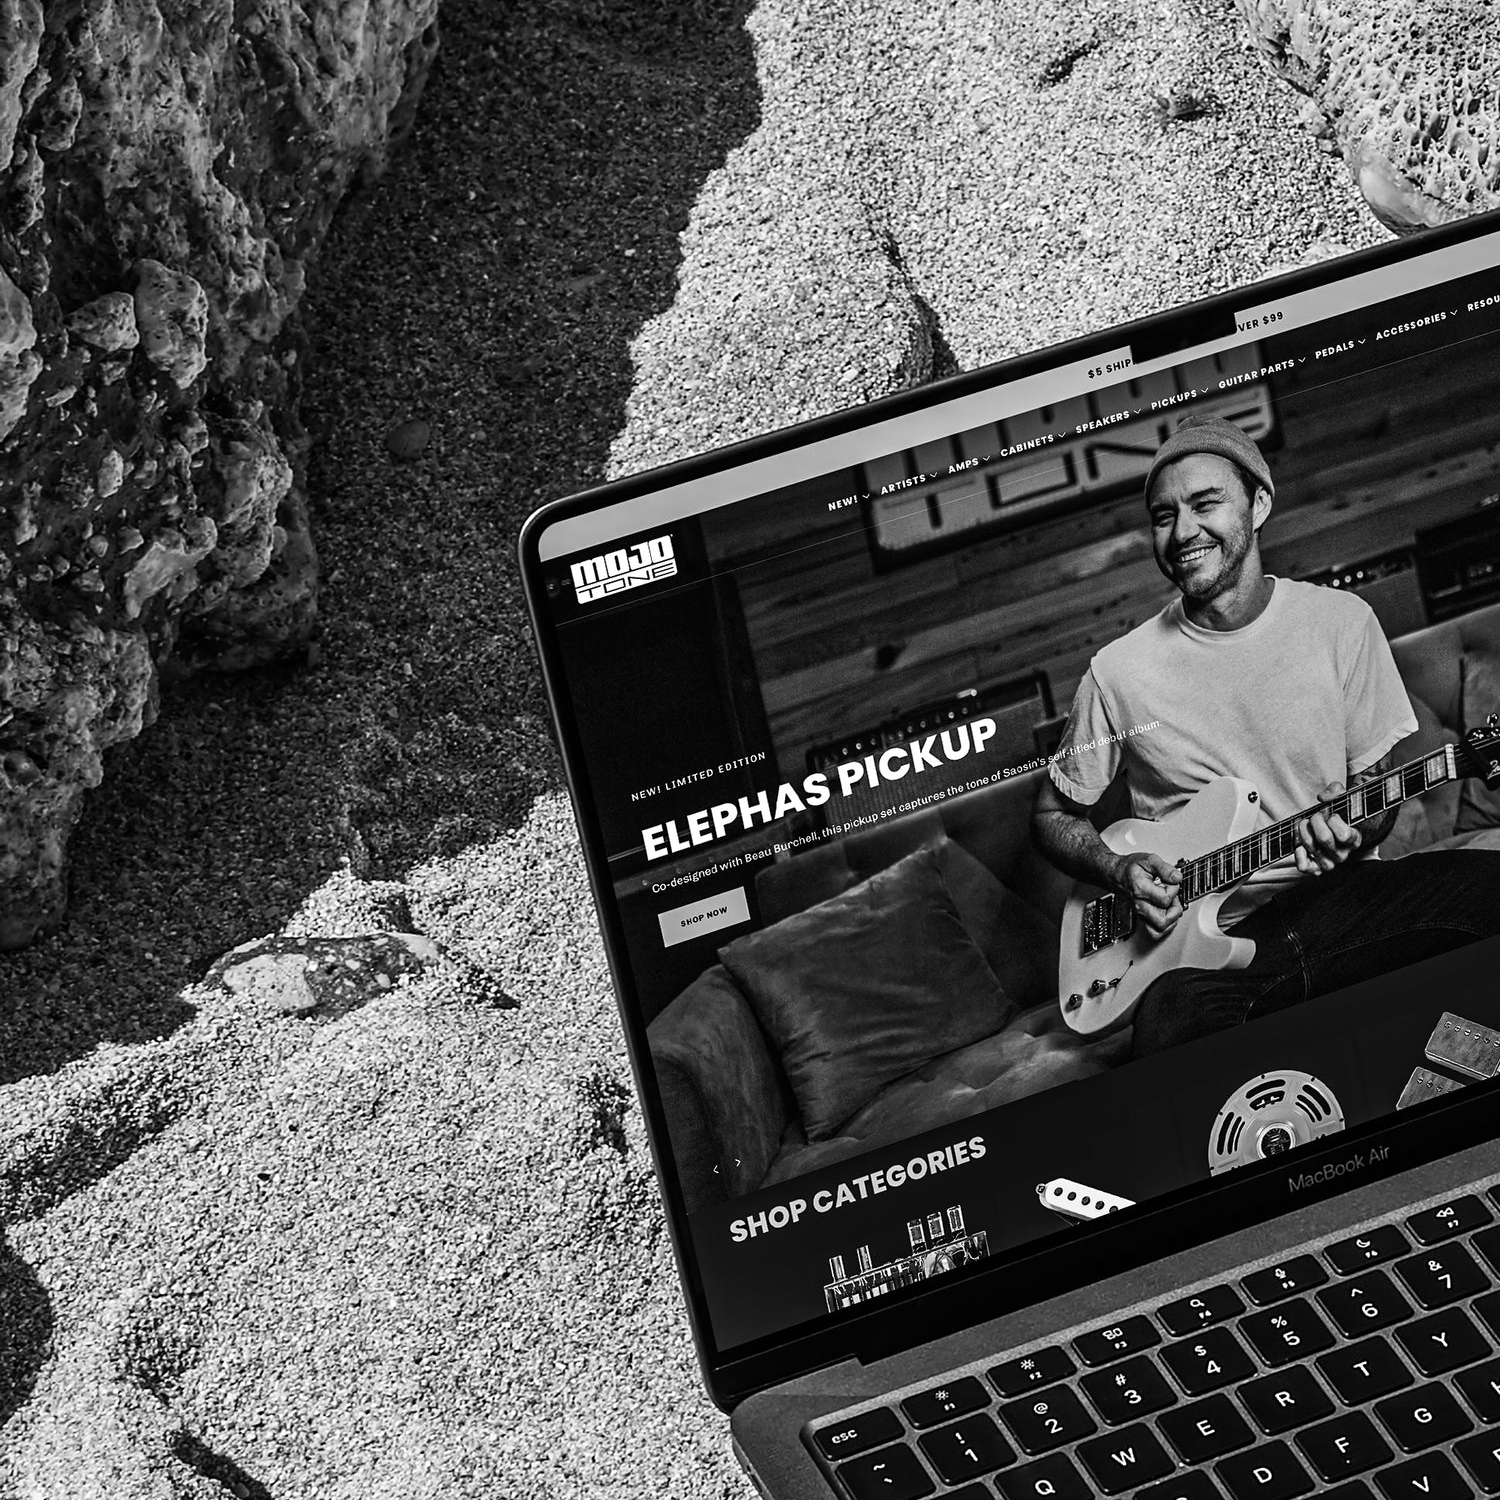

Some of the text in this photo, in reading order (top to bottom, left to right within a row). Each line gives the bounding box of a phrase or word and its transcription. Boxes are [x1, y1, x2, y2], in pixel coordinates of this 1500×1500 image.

[1088, 311, 1283, 379] $5 SHIP VER $99
[829, 496, 857, 510] NEW!
[882, 475, 926, 494] ARTISTS
[949, 458, 979, 473] AMPS
[1001, 435, 1054, 456] CABINETS
[1076, 411, 1130, 433] SPEAKERS
[1152, 390, 1197, 409] PICKUPS
[1219, 371, 1258, 388] GUITAR
[1261, 360, 1295, 375] PARTS
[1316, 341, 1355, 358] PEDALS
[1377, 312, 1447, 340] ACCESSORIES
[570, 535, 675, 588] MOJO
[577, 561, 676, 599] TONE
[632, 752, 765, 801] NEW! LIMITED EDITION
[641, 717, 998, 861] ELEPHAS PICKUP
[653, 719, 1163, 892] Co-designed with Beau Burchell, this pickup set captures the tone of Saosin's self-titled debut album.
[681, 906, 728, 928] SHOP NOW
[1288, 1146, 1390, 1193] MacBook Air
[729, 1136, 987, 1243] SHOP CATEGORIES
[1437, 1273, 1452, 1289] 7
[1361, 1303, 1379, 1318] 6
[1282, 1330, 1301, 1346] 5
[1431, 1331, 1448, 1348] Y
[1207, 1359, 1222, 1374] 4
[1352, 1360, 1370, 1377] T
[1123, 1389, 1142, 1404] 3
[1274, 1390, 1296, 1407] R
[1413, 1407, 1433, 1424] G
[1044, 1418, 1064, 1434] 2
[1196, 1419, 1216, 1436] E
[831, 1429, 858, 1444] esc
[1334, 1436, 1350, 1454] F
[964, 1448, 979, 1462] 1
[1111, 1447, 1136, 1467] W
[1252, 1467, 1273, 1484] D
[1411, 1475, 1430, 1493] V
[1034, 1479, 1056, 1496] Q
